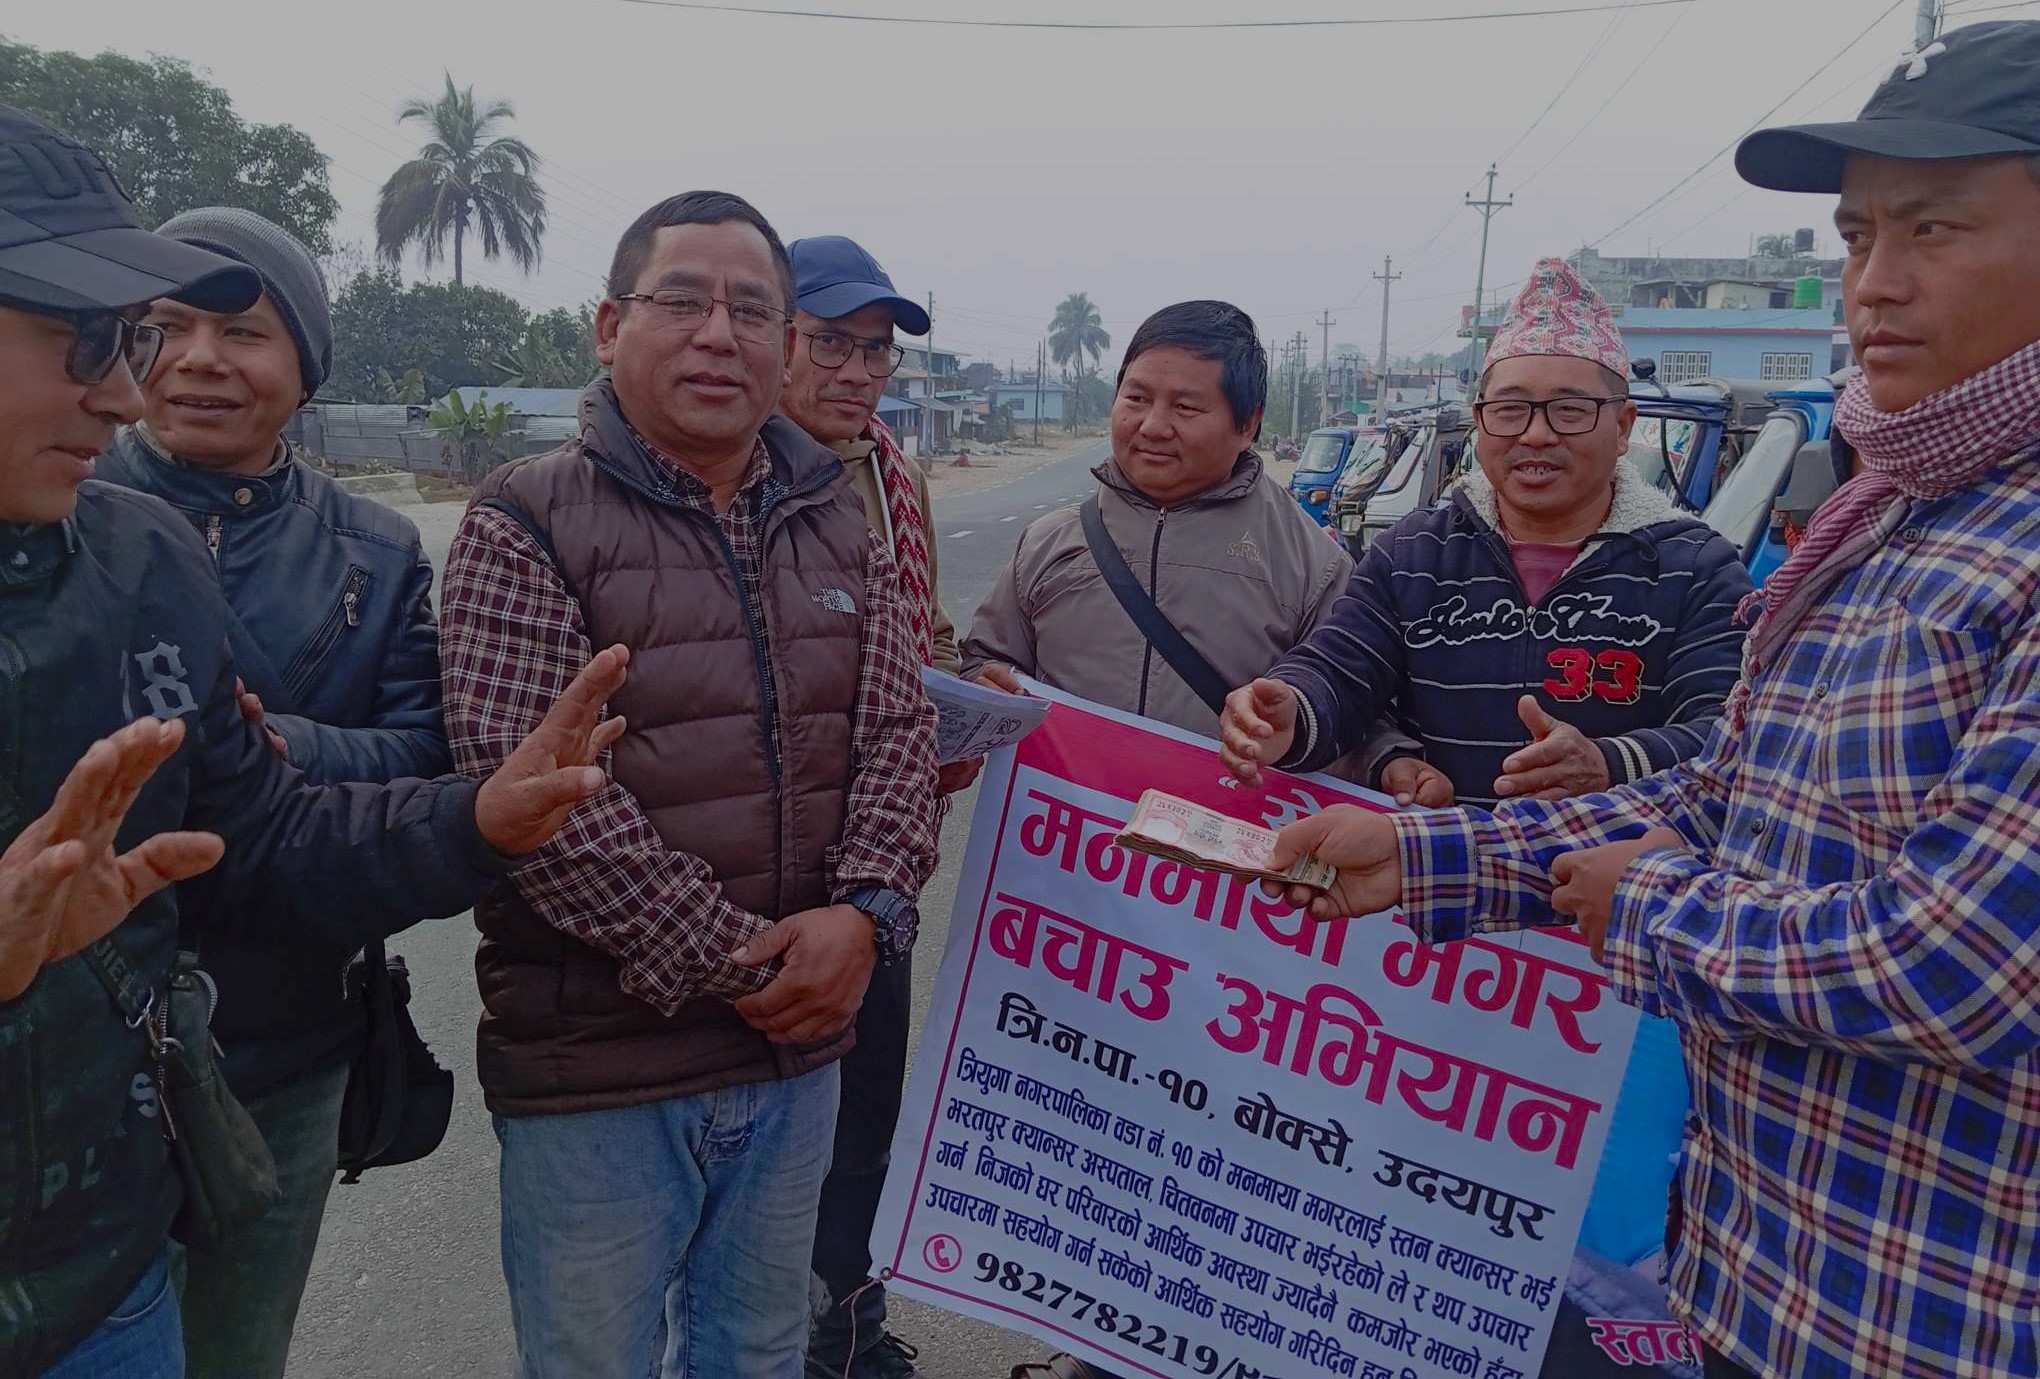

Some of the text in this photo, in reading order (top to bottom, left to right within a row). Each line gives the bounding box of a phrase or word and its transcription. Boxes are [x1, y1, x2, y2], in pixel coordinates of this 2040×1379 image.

[1544, 647, 1644, 705] 33
[989, 892, 1602, 1170] बचाउ अभियान
[926, 1183, 1000, 1227] उपचारमा
[1003, 1208, 1064, 1252] सहयोग
[1065, 1234, 1096, 1267] गर्न
[1098, 1248, 1153, 1292] सकेको
[1155, 1275, 1216, 1319] आर्थिक
[1220, 1302, 1286, 1349] सहयोग
[936, 1140, 968, 1171] गर्न
[975, 1146, 1034, 1194] निजको
[1036, 1174, 1063, 1207] घर
[1066, 1185, 1142, 1241] परिवारको
[1144, 1222, 1205, 1268] आर्थिक
[1208, 1251, 1270, 1296] अवस्था
[1347, 1307, 1422, 1357] कमजोर
[947, 1097, 1010, 1142] भरतपुर
[1012, 1120, 1079, 1168] क्यान्सर
[1159, 1175, 1239, 1236] चितवनमा
[1241, 1217, 1300, 1261] उपचार
[1303, 1241, 1384, 1294] भईरहेको
[1431, 1292, 1466, 1326] थप
[1468, 1306, 1535, 1352] उपचार
[956, 1047, 1013, 1095] त्रियुगा
[1015, 1074, 1112, 1137] नगरपालिका
[1114, 1116, 1144, 1149] वडा
[1171, 1141, 1193, 1169] १०
[1197, 1148, 1224, 1181] को
[1227, 1162, 1301, 1212] मनमाया
[1303, 1192, 1387, 1249] मगरलाई
[1390, 1226, 1434, 1263] स्तन
[1436, 1244, 1519, 1296] क्यान्सर
[1521, 1274, 1557, 1312] भई
[1234, 1092, 1353, 1173] बोक्से,
[1373, 1149, 1556, 1241] उदयपुर
